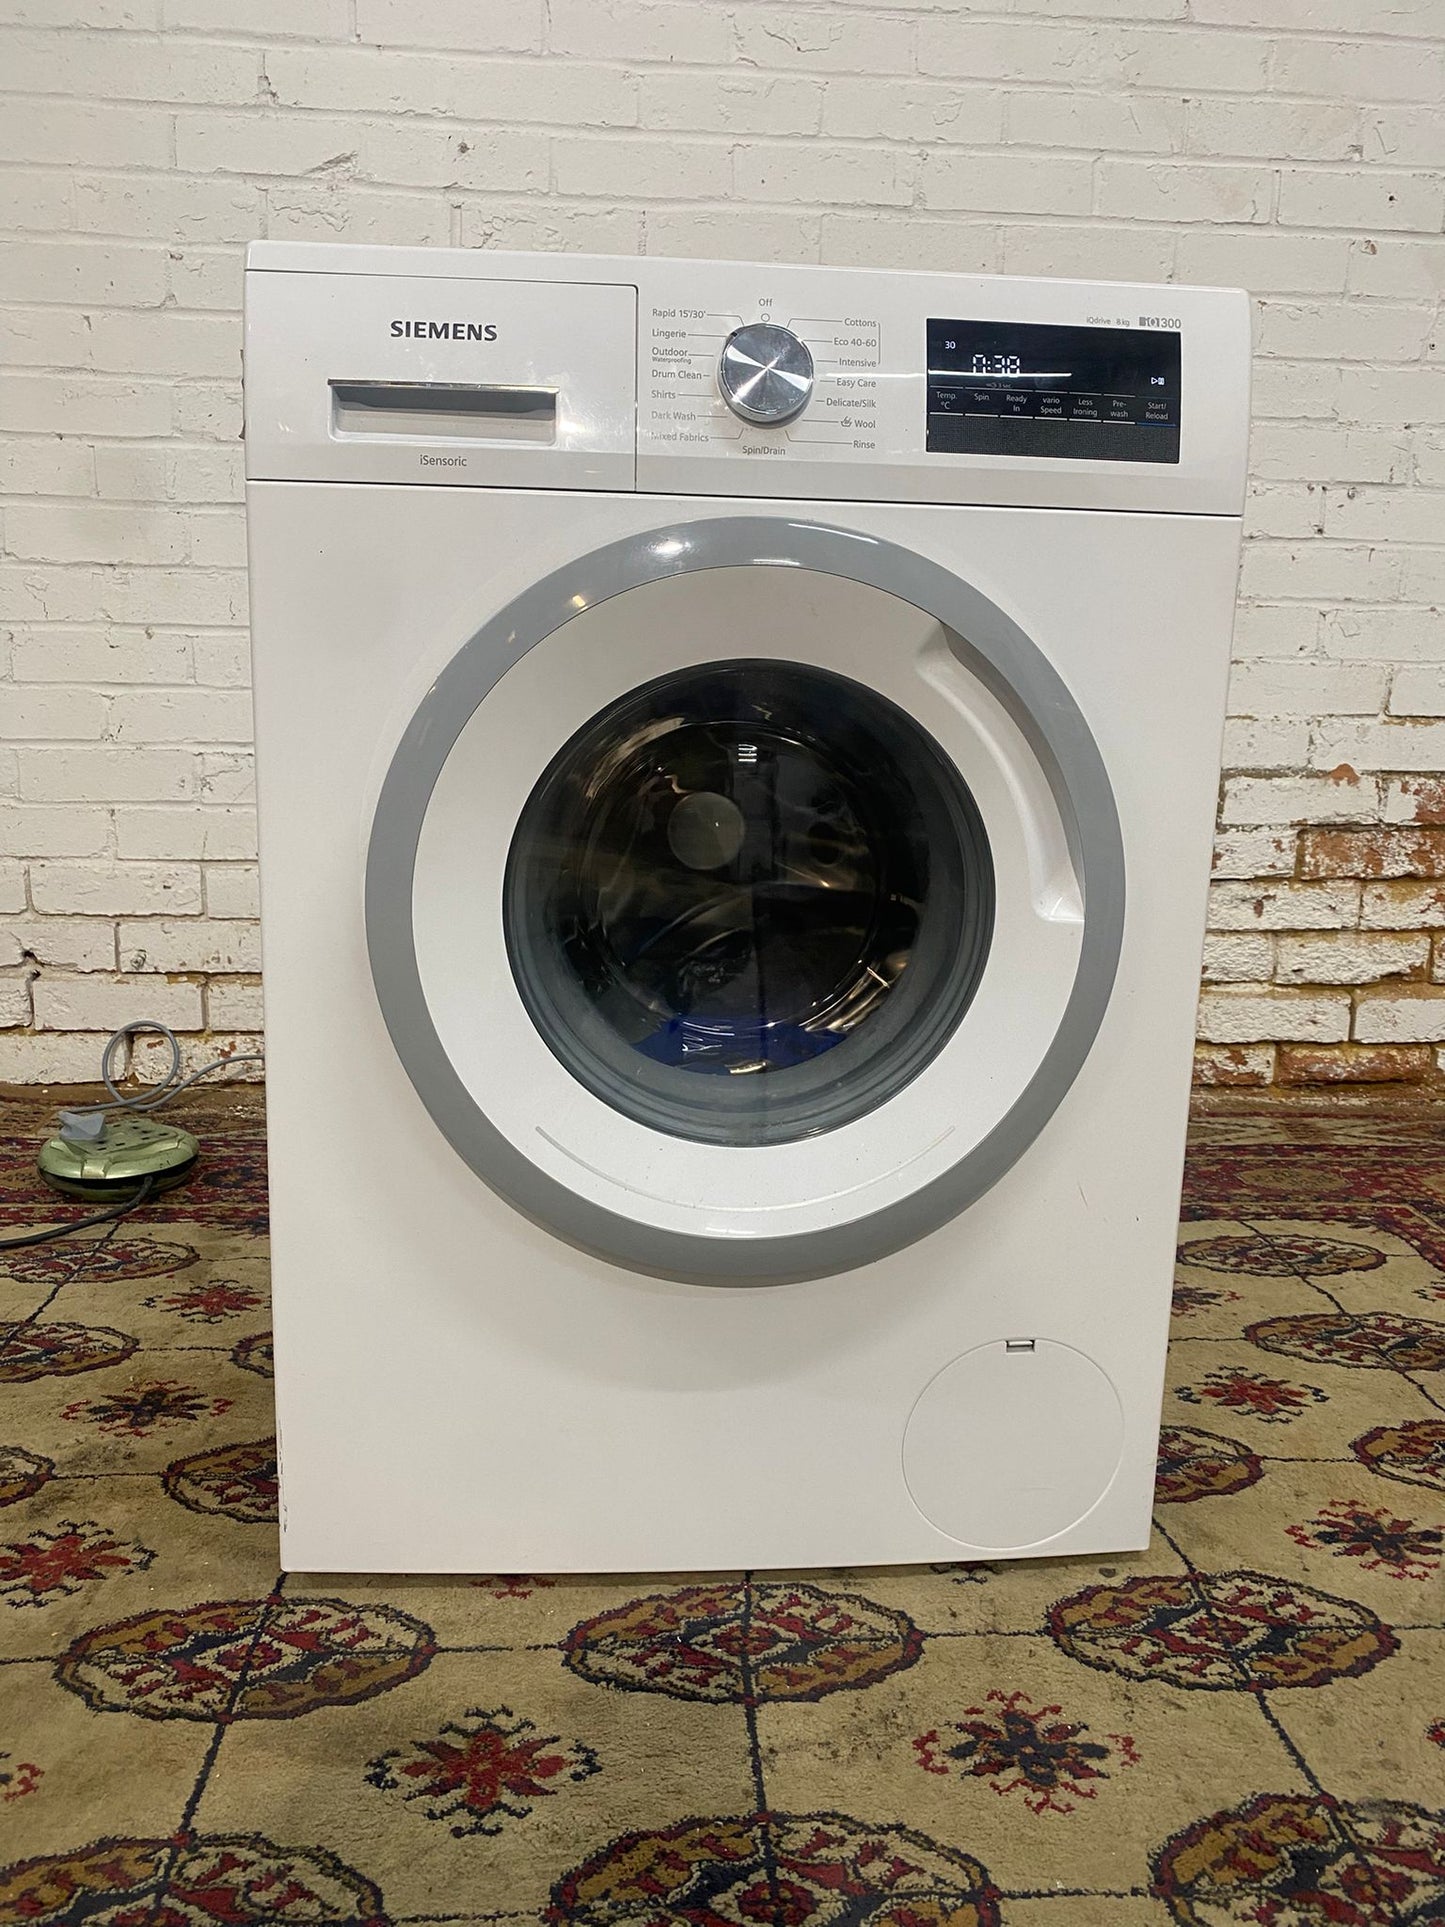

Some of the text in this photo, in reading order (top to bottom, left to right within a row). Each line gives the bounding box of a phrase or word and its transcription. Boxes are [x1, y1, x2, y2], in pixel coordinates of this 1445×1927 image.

[758, 298, 773, 307] Off
[652, 308, 677, 318] Rapid
[844, 318, 877, 328] Cottons
[1086, 316, 1111, 325] iQdrive
[390, 320, 498, 342] SIEMENS
[652, 329, 687, 339] Lingerie
[834, 338, 877, 347] Eco 40-60
[945, 340, 956, 349] 30
[652, 347, 688, 357] Outdoor
[652, 357, 692, 365] Waterproofing
[839, 358, 877, 367] Intensive
[651, 370, 702, 380] Drum Clean
[836, 378, 877, 388] Easy Care
[651, 390, 676, 399] Shirts
[936, 391, 958, 400] Temp.
[974, 393, 990, 402] Spin
[1006, 394, 1028, 404] Ready
[826, 398, 877, 408] Delicate/Silk
[1042, 397, 1060, 405] vario
[1078, 398, 1093, 406] Less
[1112, 400, 1127, 408] Pre-
[1040, 406, 1062, 415] Speed
[1147, 401, 1167, 411] Start/
[651, 411, 696, 421] Dark Wash
[1073, 408, 1098, 418] Ironing
[1110, 410, 1129, 418] wash
[1145, 411, 1169, 421] Reload
[854, 420, 876, 429] Wool
[679, 432, 710, 442] Fabrics
[853, 440, 876, 449] Rinse
[742, 446, 786, 456] Spin/Drain
[419, 454, 468, 468] iSensoric
